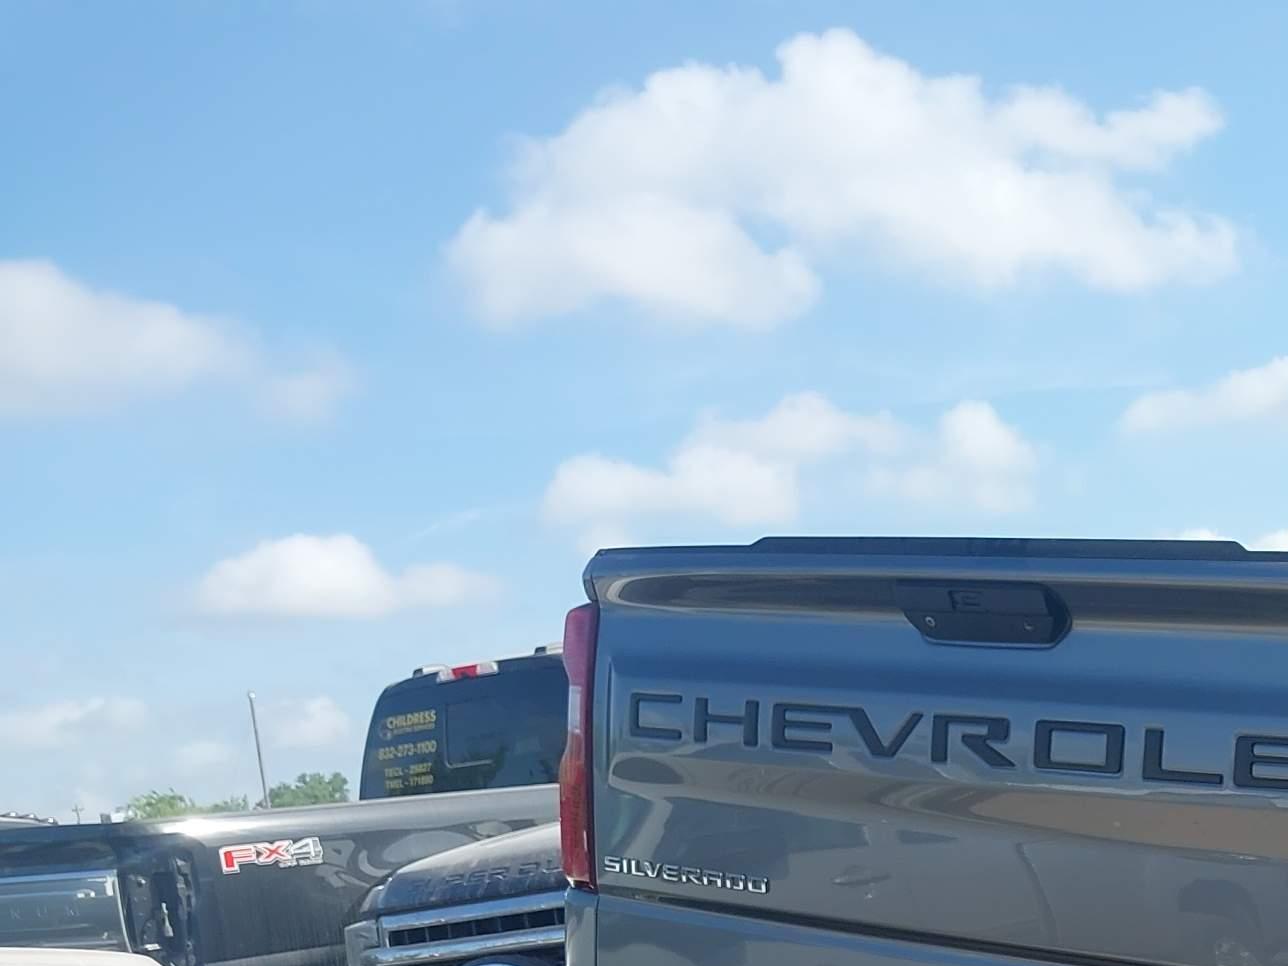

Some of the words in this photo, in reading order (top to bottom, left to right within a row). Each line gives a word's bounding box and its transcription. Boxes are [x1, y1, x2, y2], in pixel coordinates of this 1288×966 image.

[386, 709, 437, 729] CHILDRESS
[218, 836, 323, 875] FX4
[604, 855, 769, 894] SILVERADO
